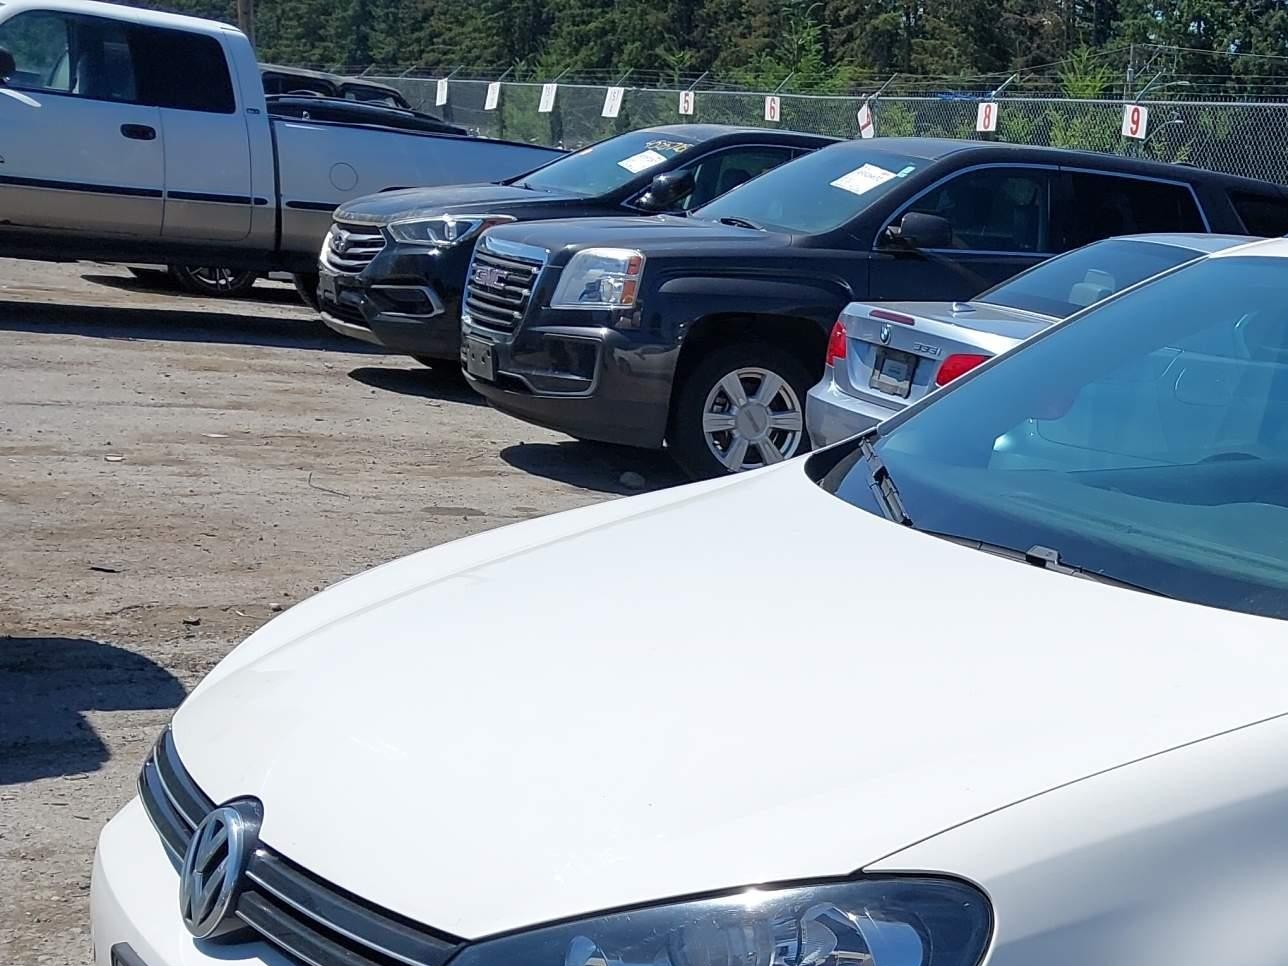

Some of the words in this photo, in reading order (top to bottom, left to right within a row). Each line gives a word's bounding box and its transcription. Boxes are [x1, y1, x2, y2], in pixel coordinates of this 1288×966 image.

[684, 92, 690, 113] 5
[769, 98, 776, 119] 6
[982, 104, 992, 130] 8
[1130, 107, 1141, 136] 9
